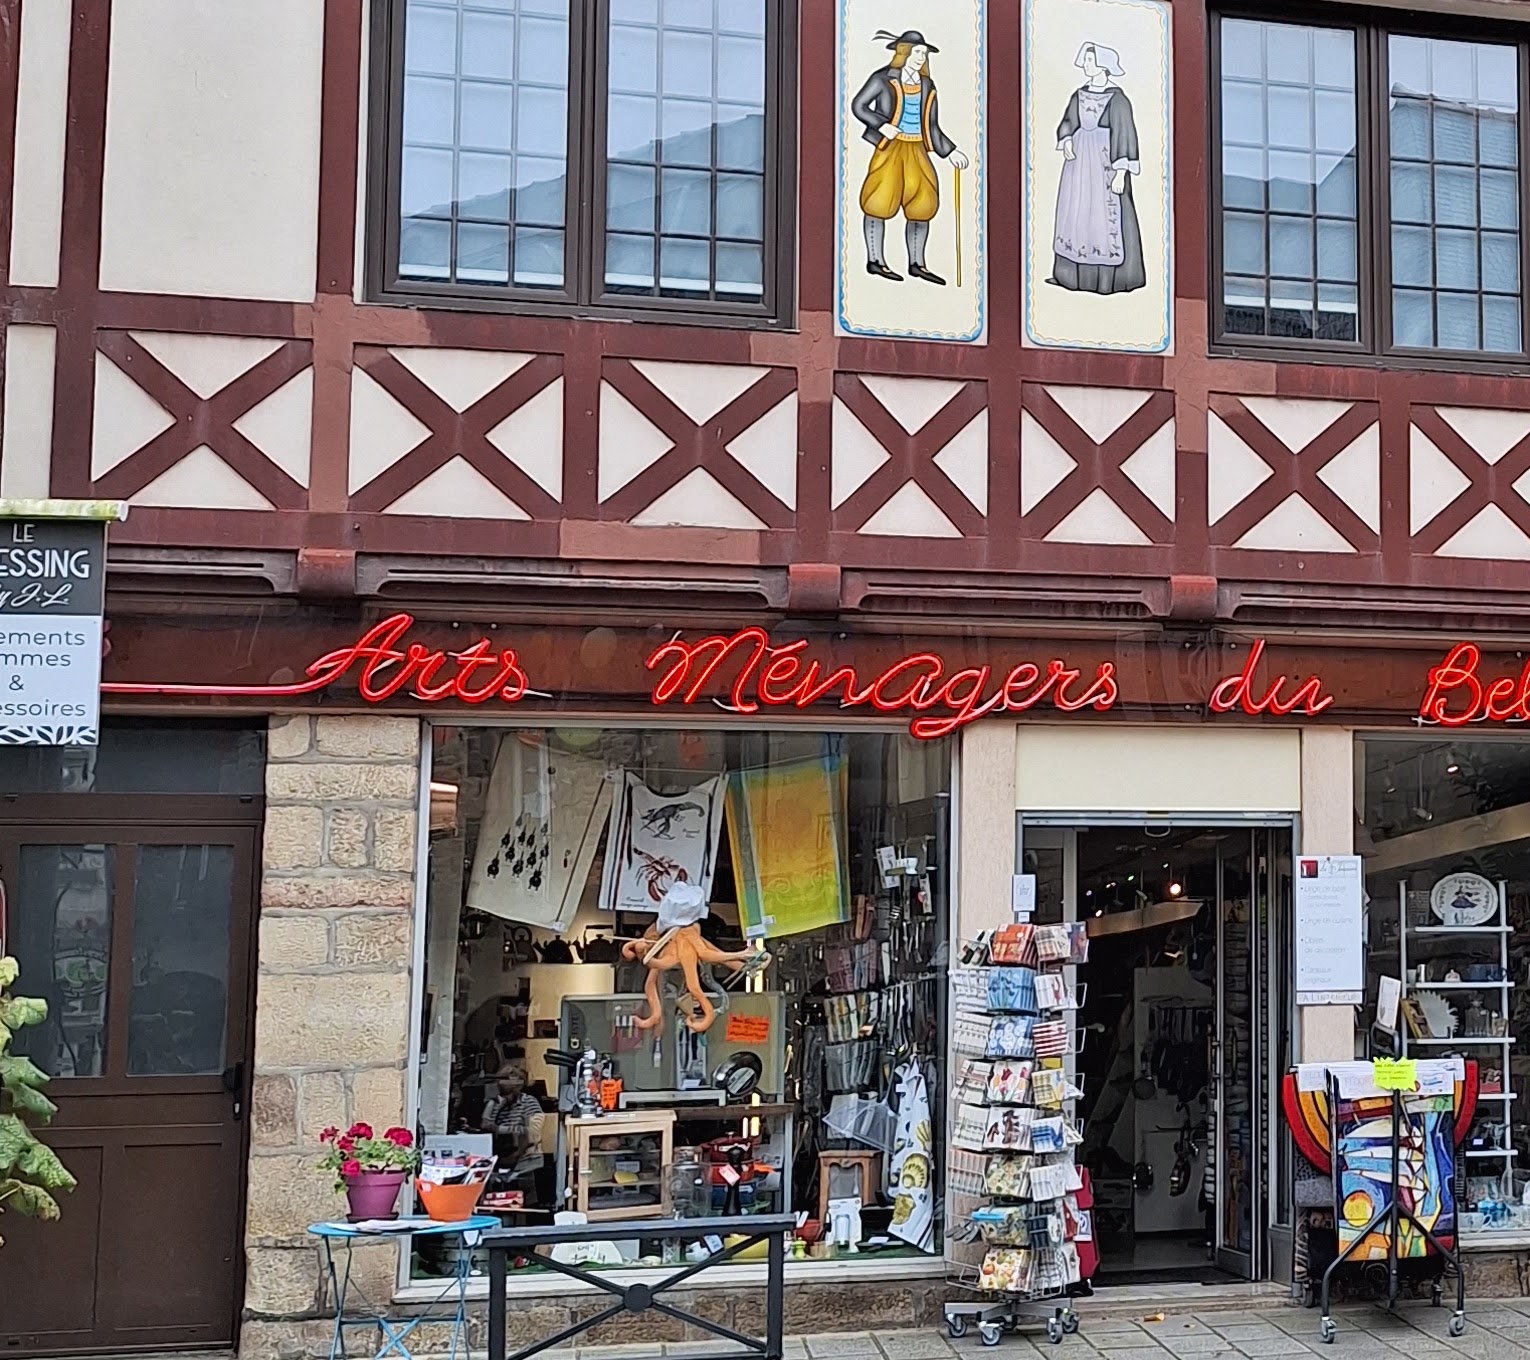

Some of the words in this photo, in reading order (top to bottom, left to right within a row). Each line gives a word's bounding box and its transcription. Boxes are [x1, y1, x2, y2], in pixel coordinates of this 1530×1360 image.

[12, 523, 36, 543] LE
[306, 613, 535, 703] Arts
[8, 674, 25, 691] &
[646, 626, 1121, 740] Ménagers
[1209, 639, 1335, 716] du
[0, 699, 86, 716] ssoires
